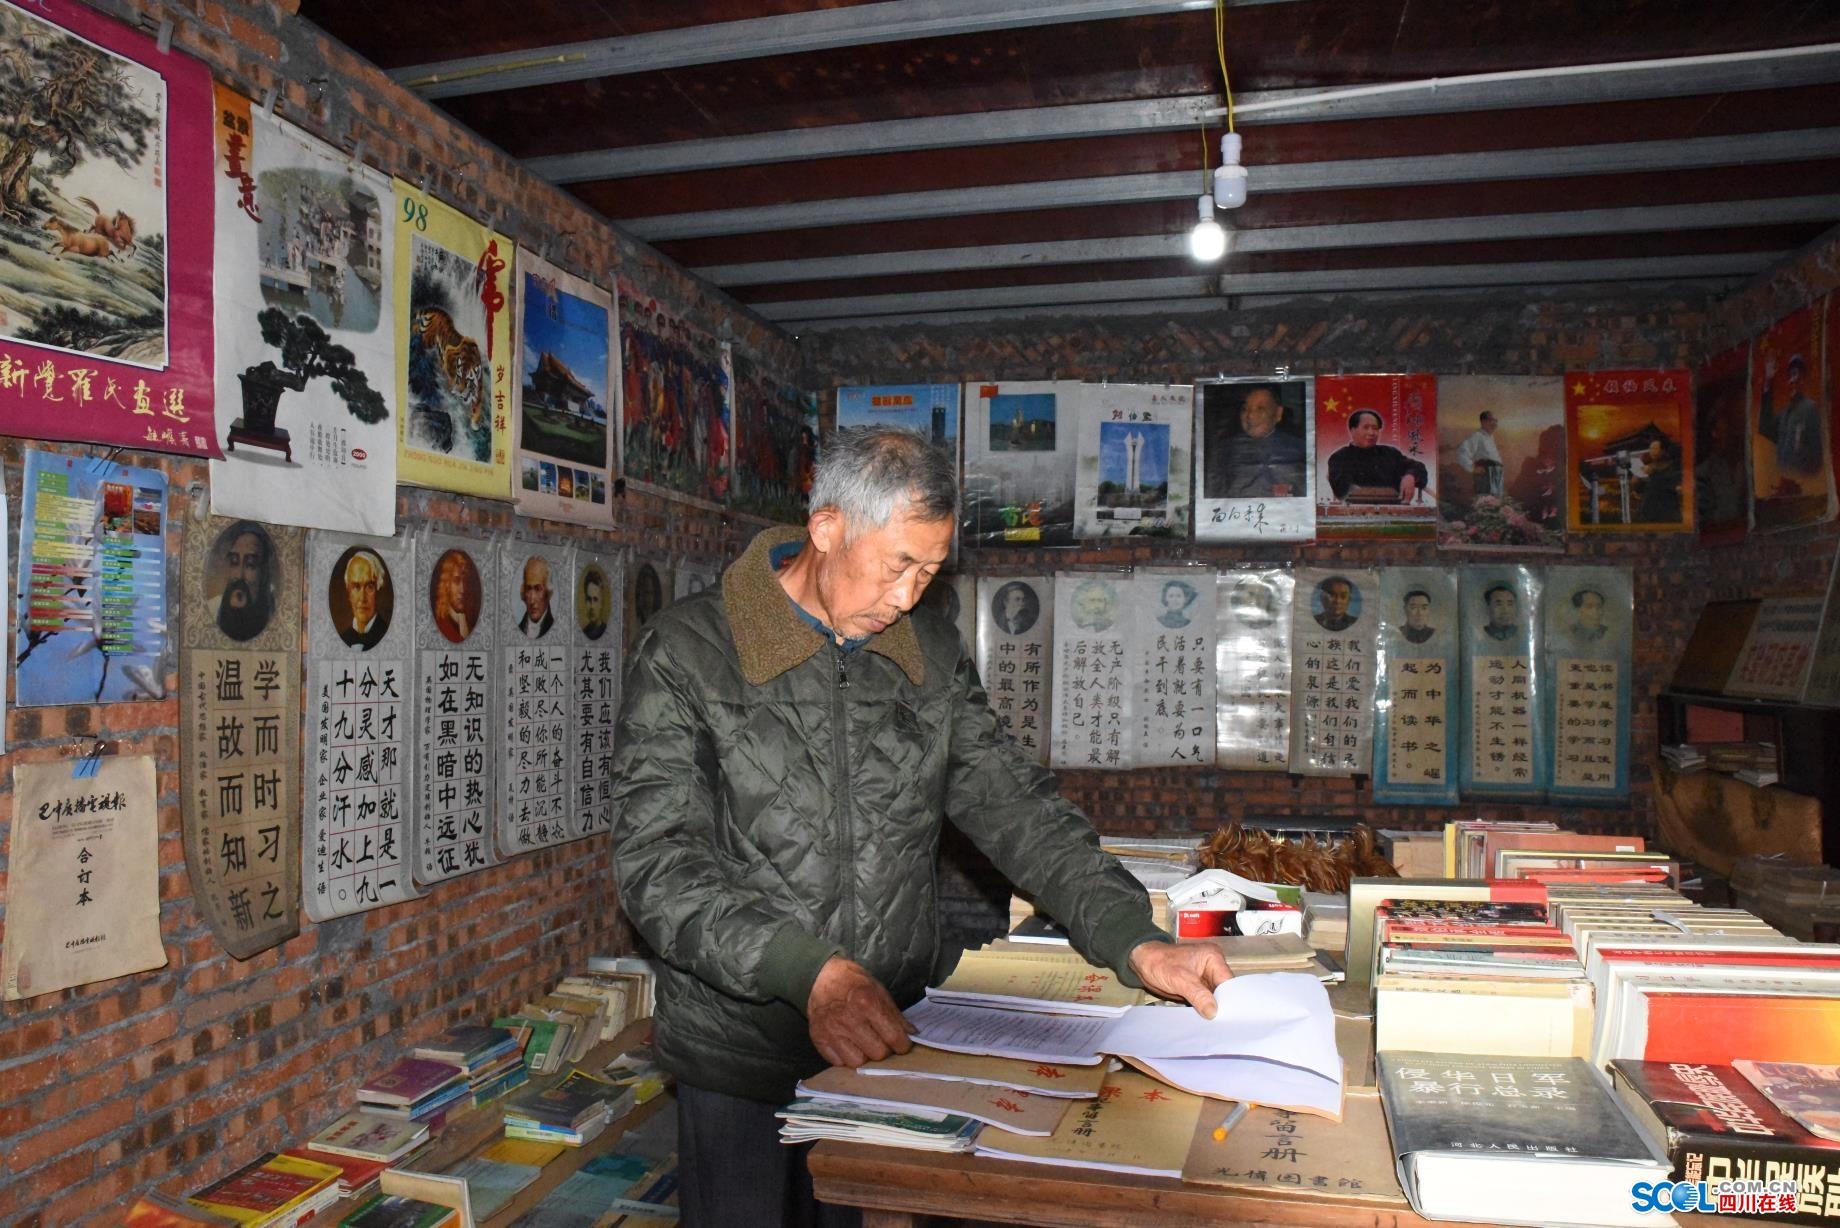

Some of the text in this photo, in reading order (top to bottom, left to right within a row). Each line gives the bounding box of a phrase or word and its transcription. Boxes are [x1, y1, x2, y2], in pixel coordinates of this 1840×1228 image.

[402, 197, 429, 232] 98
[436, 653, 461, 875] 如在黑暗中远征
[462, 655, 486, 868] 无知识的热心犹
[518, 650, 536, 847] 和坚毅的尽力去做
[549, 655, 566, 841] 一个人的奋斗不论
[580, 649, 595, 833] 尤其要有自信力
[1087, 639, 1106, 765] 放全人类才能最
[1104, 639, 1124, 766] 无产阶级只有解
[1190, 634, 1205, 763] 只要有一口气
[1423, 662, 1443, 781] 为中华之崛
[215, 658, 255, 932] 温故而知新
[253, 659, 285, 921] 学而时习之
[355, 665, 380, 904] 分灵感加上九
[377, 668, 400, 890] 天才那就是一
[75, 847, 94, 907] 合订本
[1395, 1067, 1572, 1087] 侵华日军
[1410, 1080, 1570, 1100] 暴行总录
[1450, 1141, 1579, 1154] 河北人民出版社
